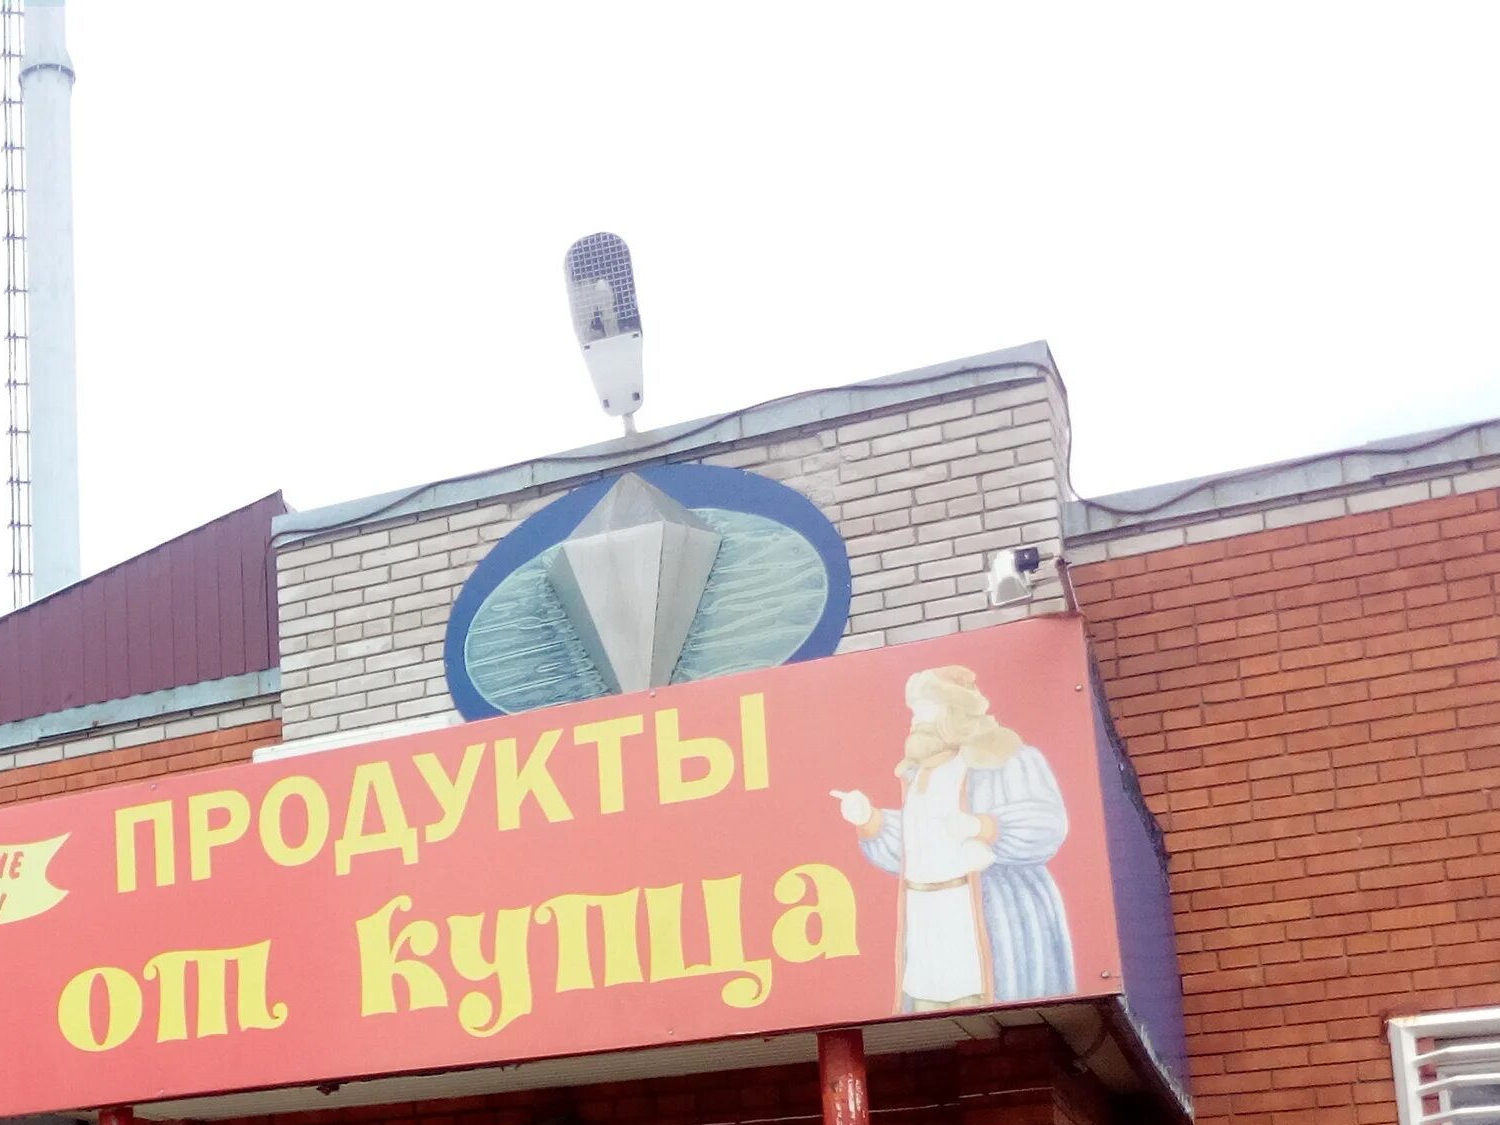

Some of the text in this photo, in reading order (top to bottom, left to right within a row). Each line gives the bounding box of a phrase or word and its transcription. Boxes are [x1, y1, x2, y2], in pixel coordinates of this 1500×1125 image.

[115, 693, 770, 893] ПРОДУКТЫ
[57, 863, 860, 1052] от купца
